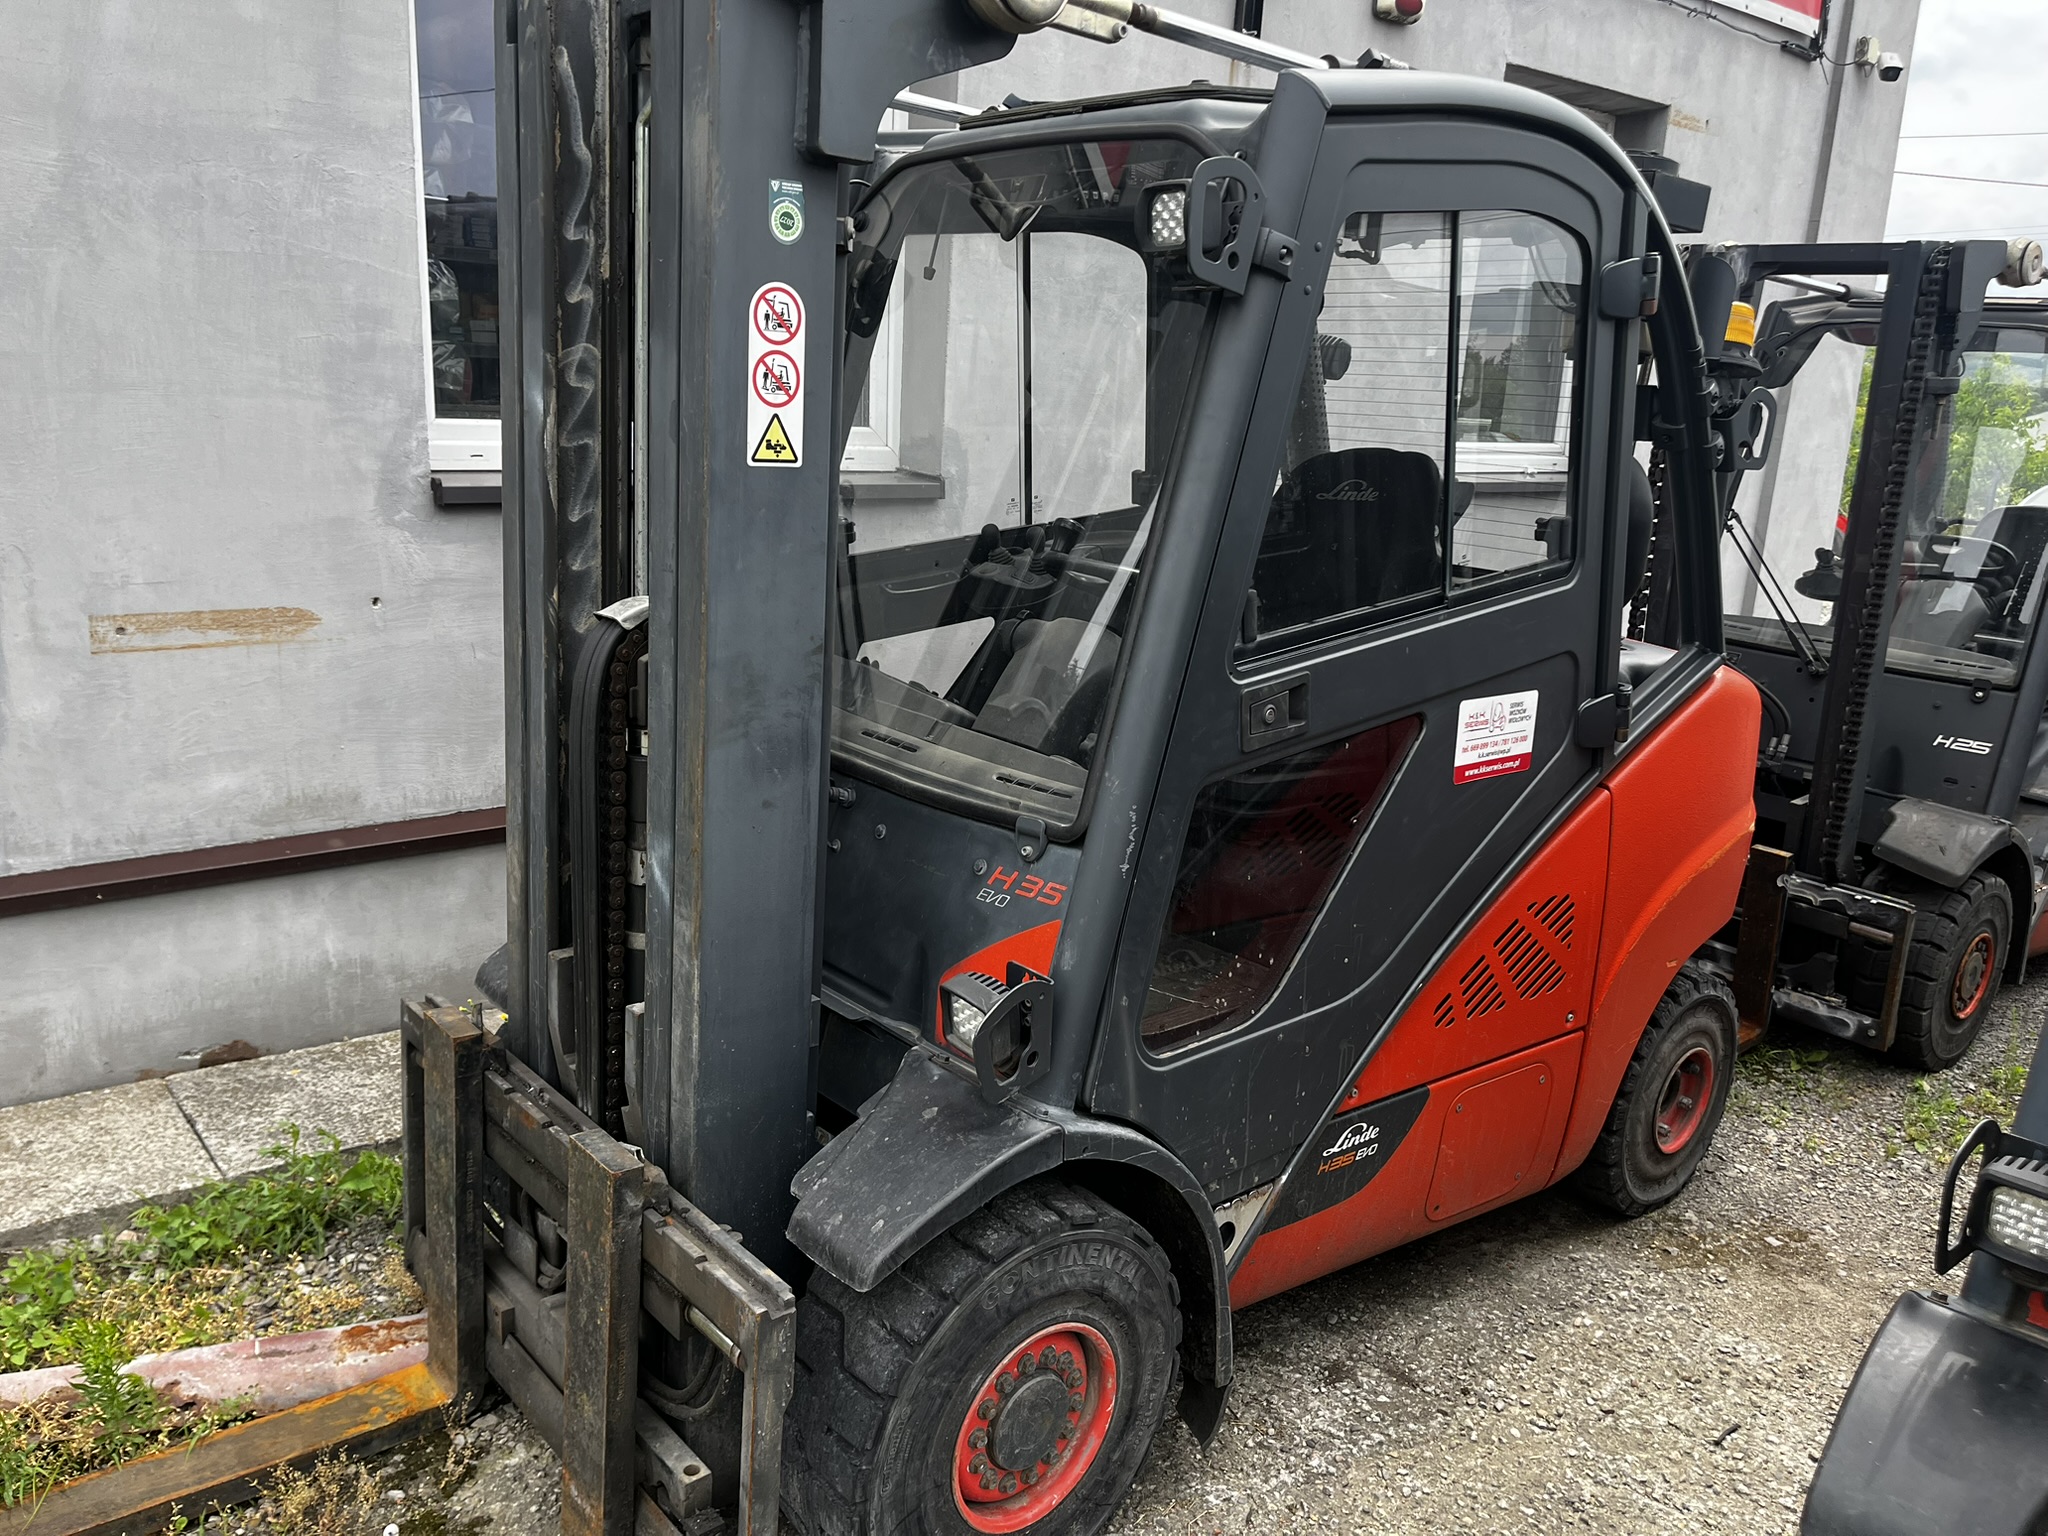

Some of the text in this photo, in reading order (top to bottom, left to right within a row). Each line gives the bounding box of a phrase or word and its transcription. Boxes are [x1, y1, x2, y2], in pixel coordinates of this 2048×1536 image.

[779, 215, 795, 227] 2027
[1315, 479, 1379, 501] Linde
[1461, 745, 1469, 753] tel.
[1932, 734, 1994, 755] H25
[976, 887, 1011, 908] EVO
[1322, 1122, 1380, 1157] Linde
[1317, 1143, 1379, 1176] H35 EVO
[981, 1242, 1147, 1310] CONTINENTAL
